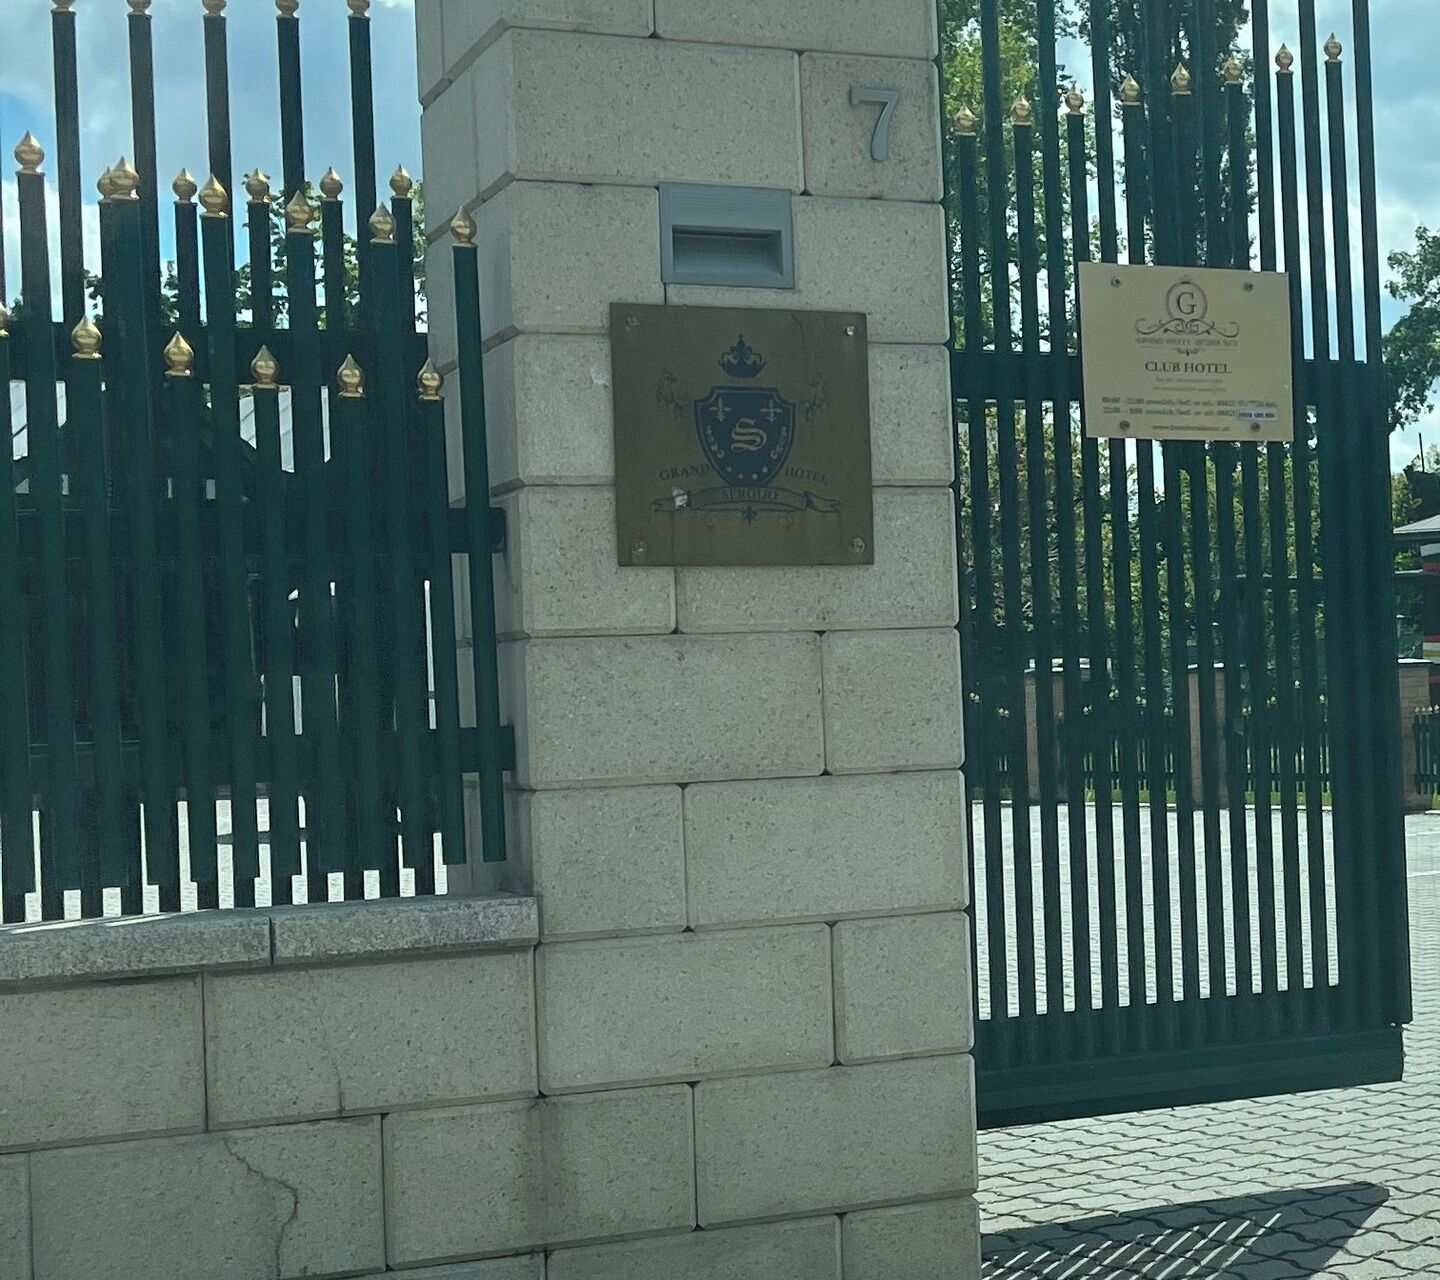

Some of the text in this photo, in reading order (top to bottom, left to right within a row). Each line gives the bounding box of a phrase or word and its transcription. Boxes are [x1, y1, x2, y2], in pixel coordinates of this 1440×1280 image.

[848, 86, 900, 162] 7
[1177, 291, 1197, 315] G
[1145, 362, 1233, 374] CLUB HOTEL
[731, 417, 767, 453] S
[658, 463, 829, 485] GRAND HOTEL
